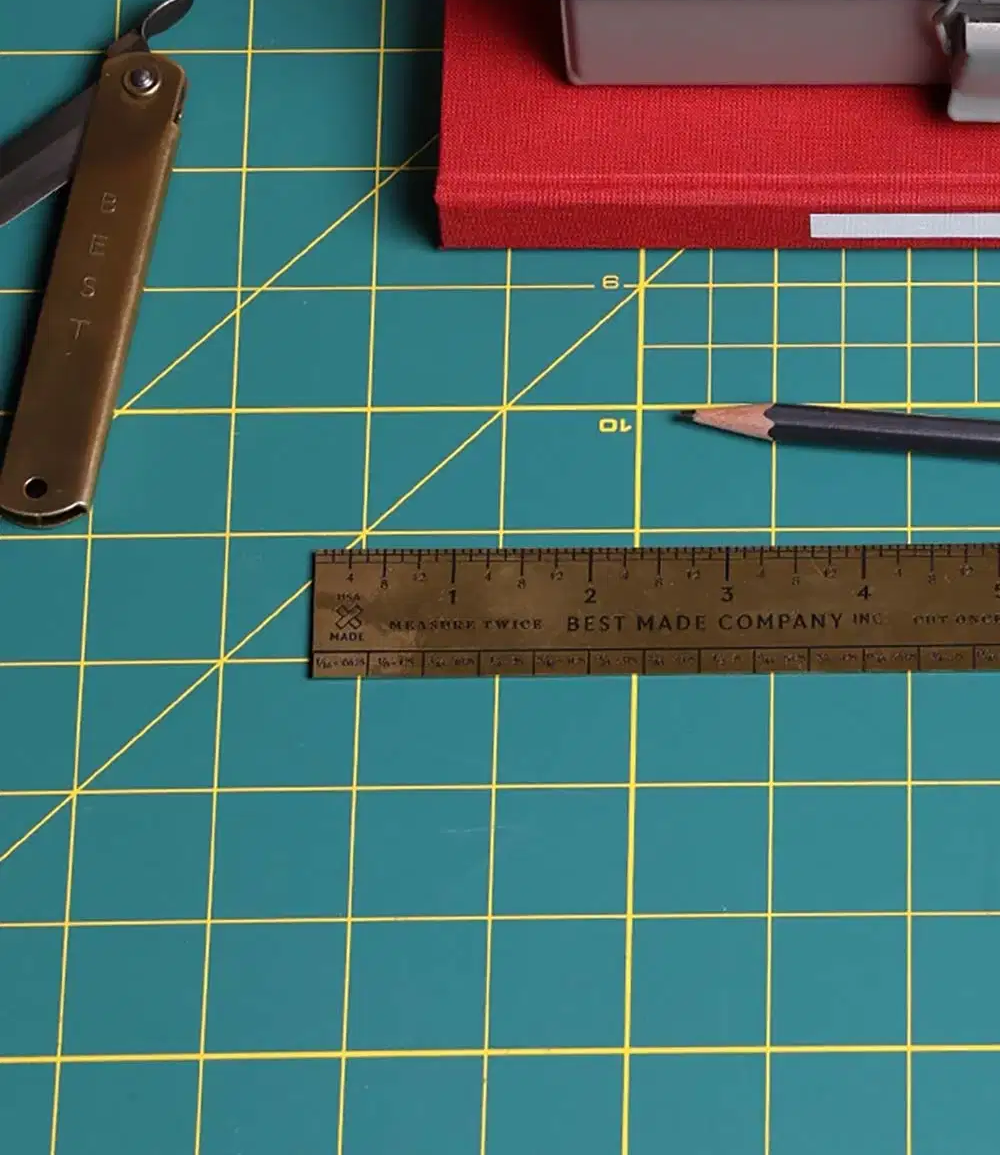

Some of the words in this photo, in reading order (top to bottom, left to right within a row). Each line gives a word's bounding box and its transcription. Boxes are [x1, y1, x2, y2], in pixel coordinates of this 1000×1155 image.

[598, 417, 633, 433] 10
[448, 589, 457, 605] 1
[583, 587, 597, 604] 2
[720, 586, 734, 602] 3
[857, 584, 872, 600] 4
[484, 618, 543, 630] TWICE
[566, 614, 628, 632] BEST
[636, 614, 707, 632] MADE
[718, 612, 844, 631] COMPANY
[329, 632, 365, 642] MADE
